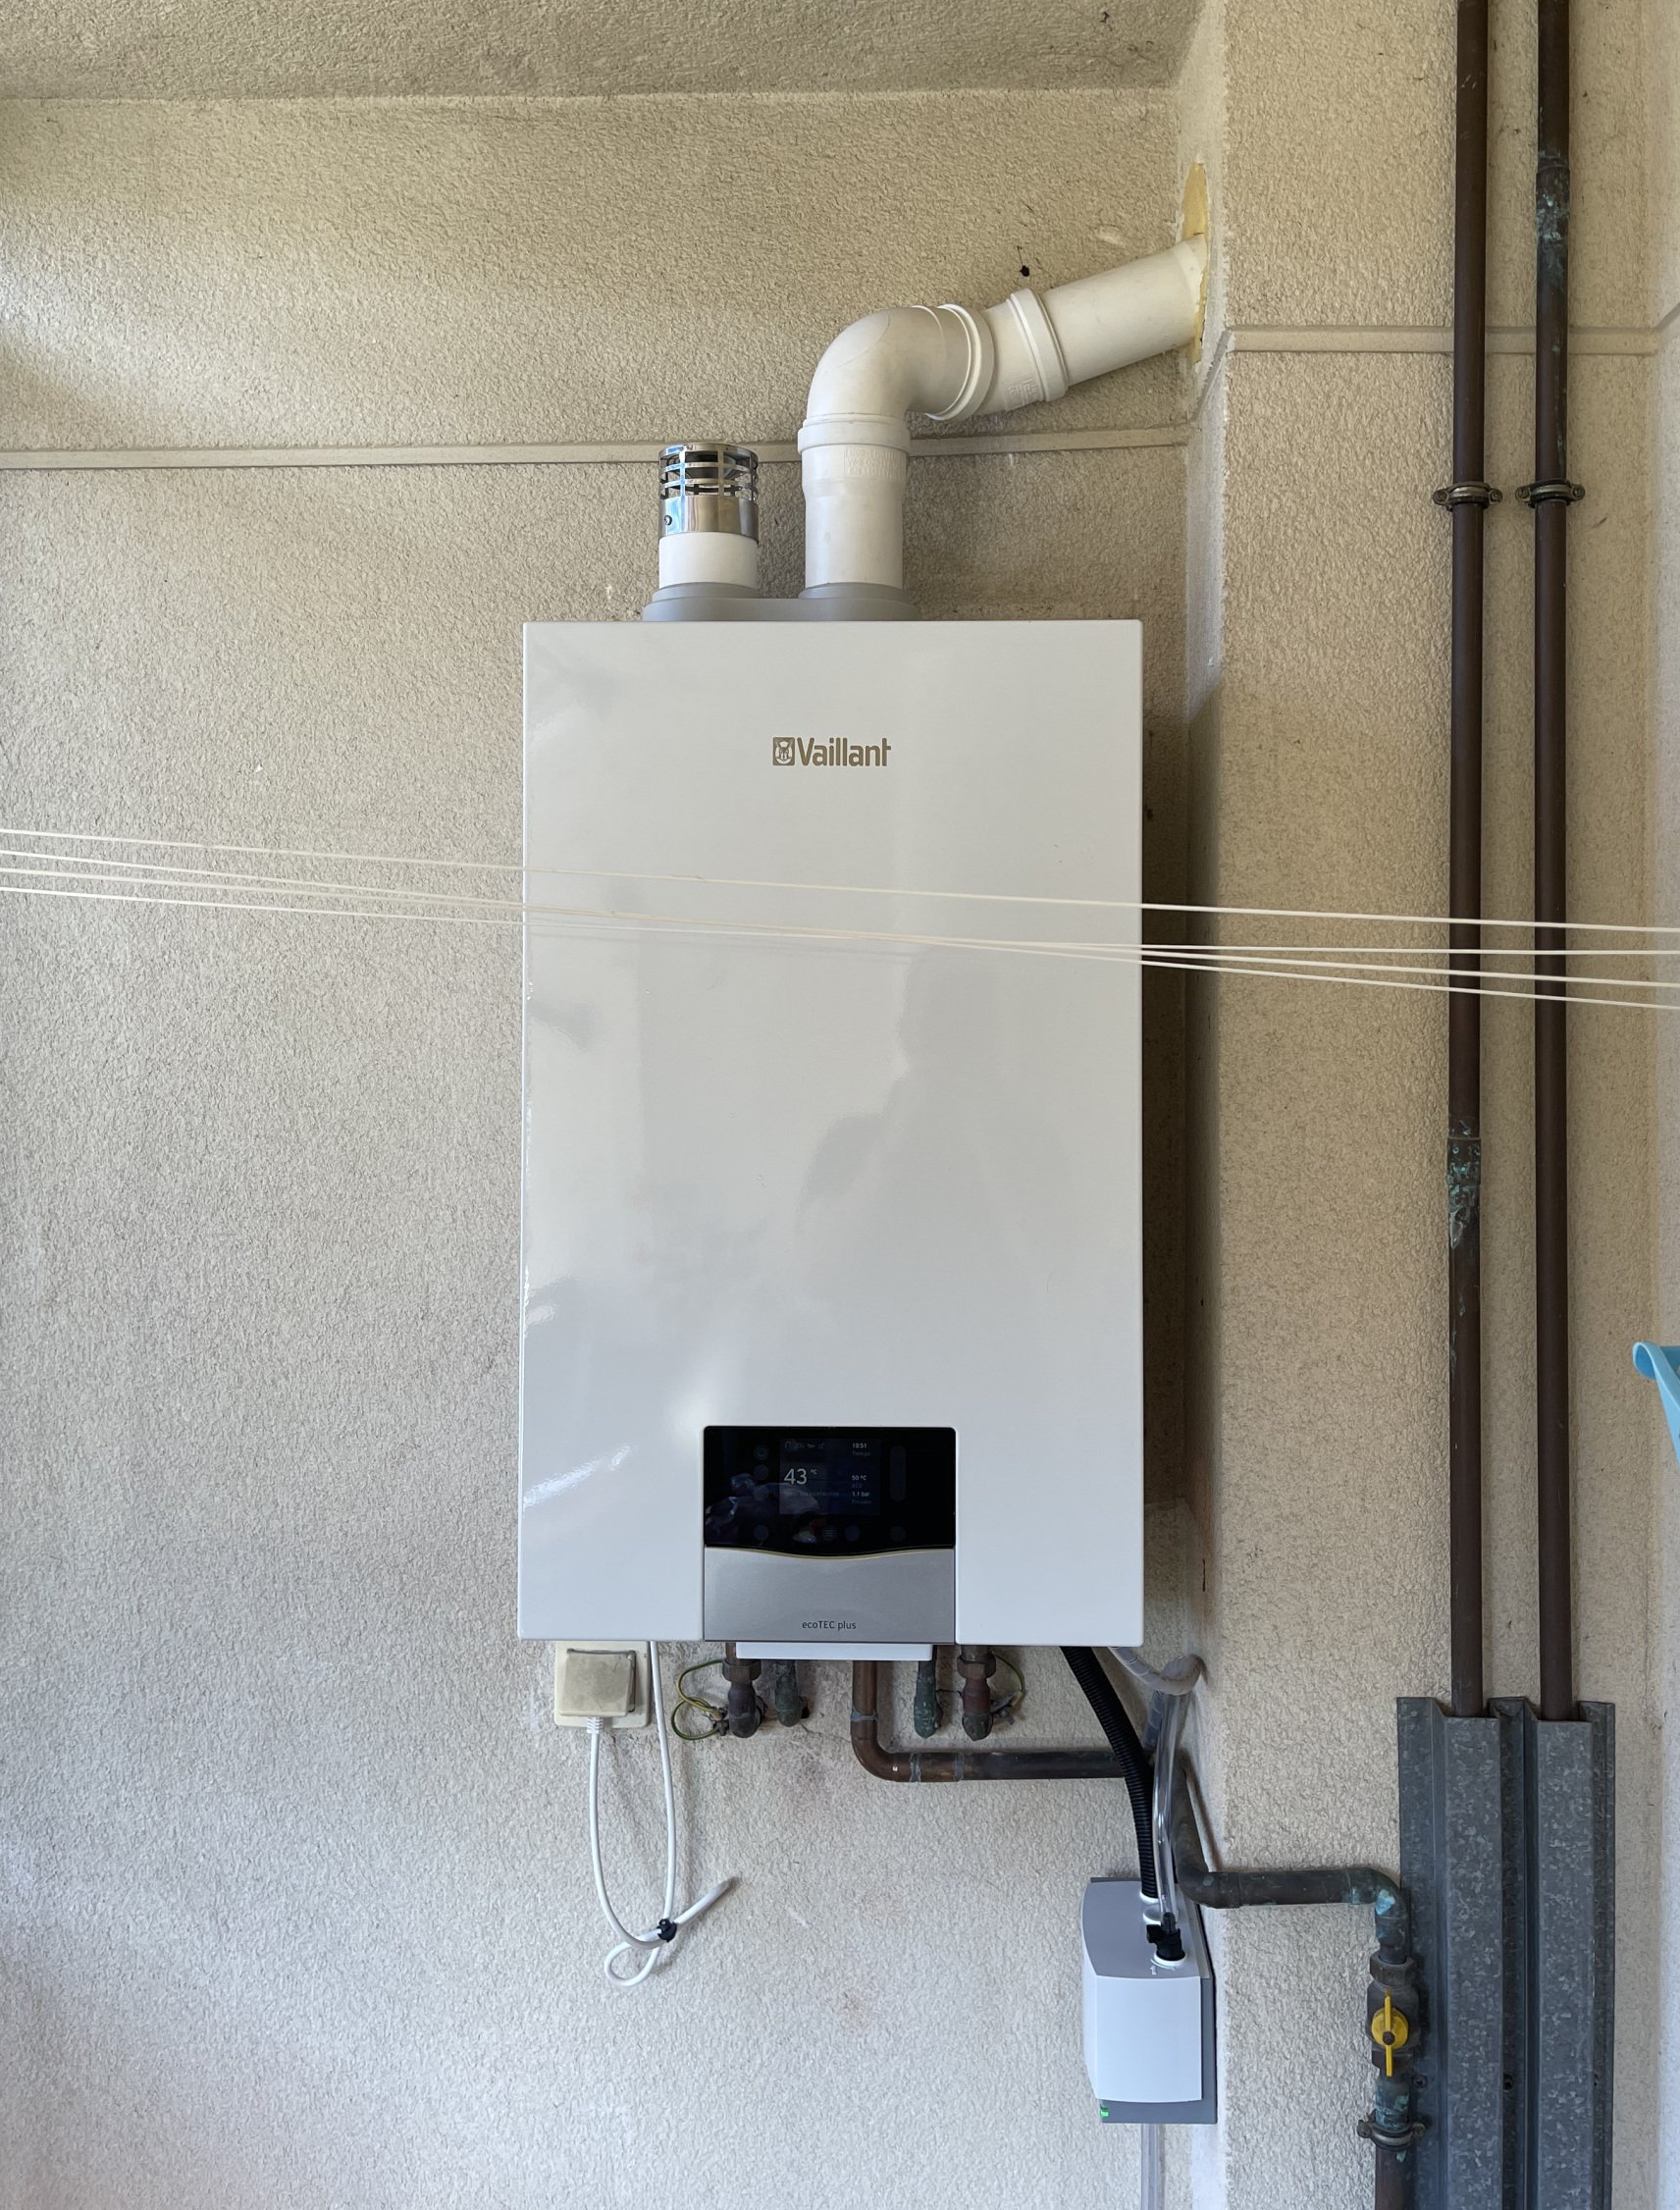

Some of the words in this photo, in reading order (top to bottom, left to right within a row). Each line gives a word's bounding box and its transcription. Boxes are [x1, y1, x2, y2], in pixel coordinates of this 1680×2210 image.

[797, 737, 891, 766] Vaillant
[783, 1467, 808, 1485] 43
[802, 1620, 835, 1629] ecoTEC
[838, 1620, 857, 1632] plus
